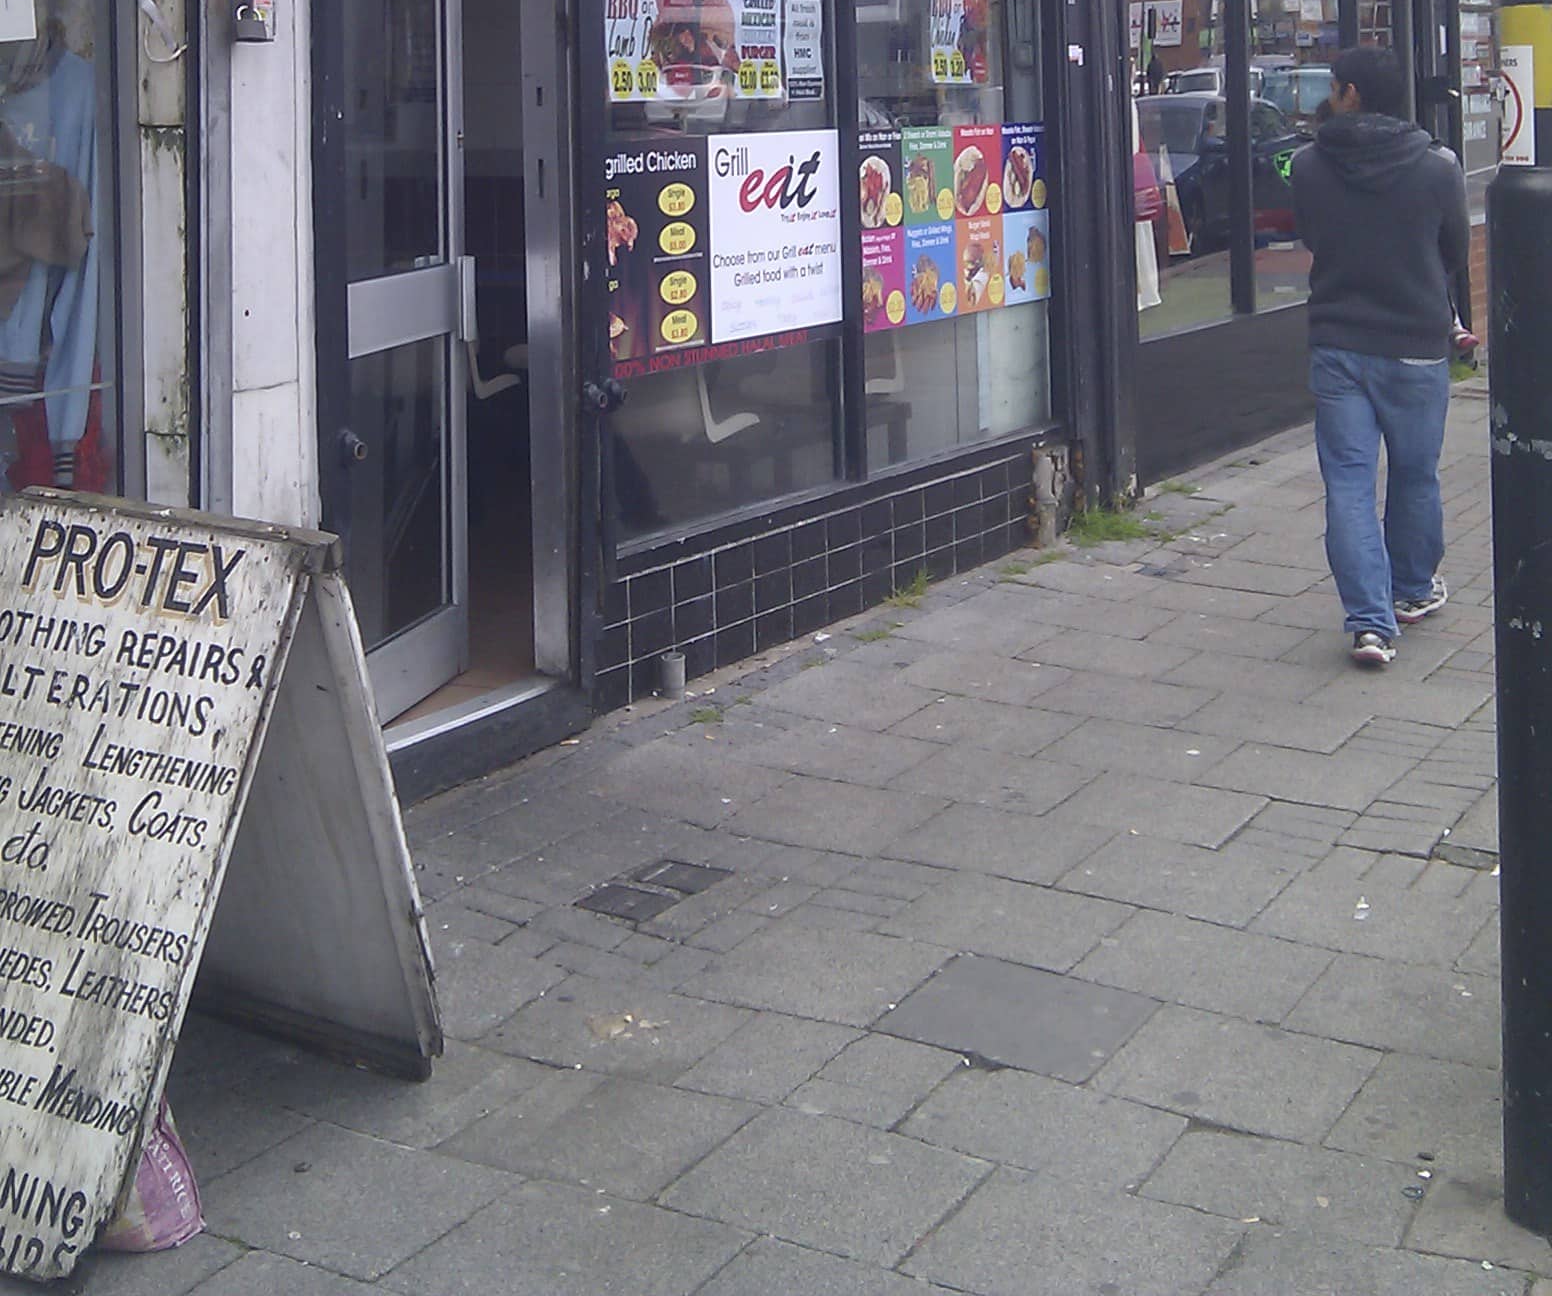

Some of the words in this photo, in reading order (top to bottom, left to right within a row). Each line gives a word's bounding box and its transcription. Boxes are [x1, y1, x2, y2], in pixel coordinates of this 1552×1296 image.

[605, 152, 644, 179] grilled
[646, 150, 697, 172] Chicken
[715, 147, 749, 177] Grill
[712, 254, 745, 268] Choose
[747, 250, 765, 264] from
[767, 250, 779, 262] our
[782, 245, 796, 259] Grill
[815, 243, 836, 255] menu
[734, 271, 761, 287] Grilled
[763, 267, 781, 282] food
[783, 265, 798, 279] with
[800, 266, 806, 277] a
[807, 262, 823, 276] twist
[22, 518, 247, 625] PRO-TEX
[116, 629, 245, 685] REPAIRS
[0, 721, 64, 759] ENING
[82, 723, 238, 796] LENGTHENING
[18, 766, 117, 833] JACKETS,
[76, 891, 188, 964] TROUSERS
[0, 947, 52, 993] EDES,
[59, 947, 174, 1021] LEATHERS
[33, 1063, 138, 1136] MENDING
